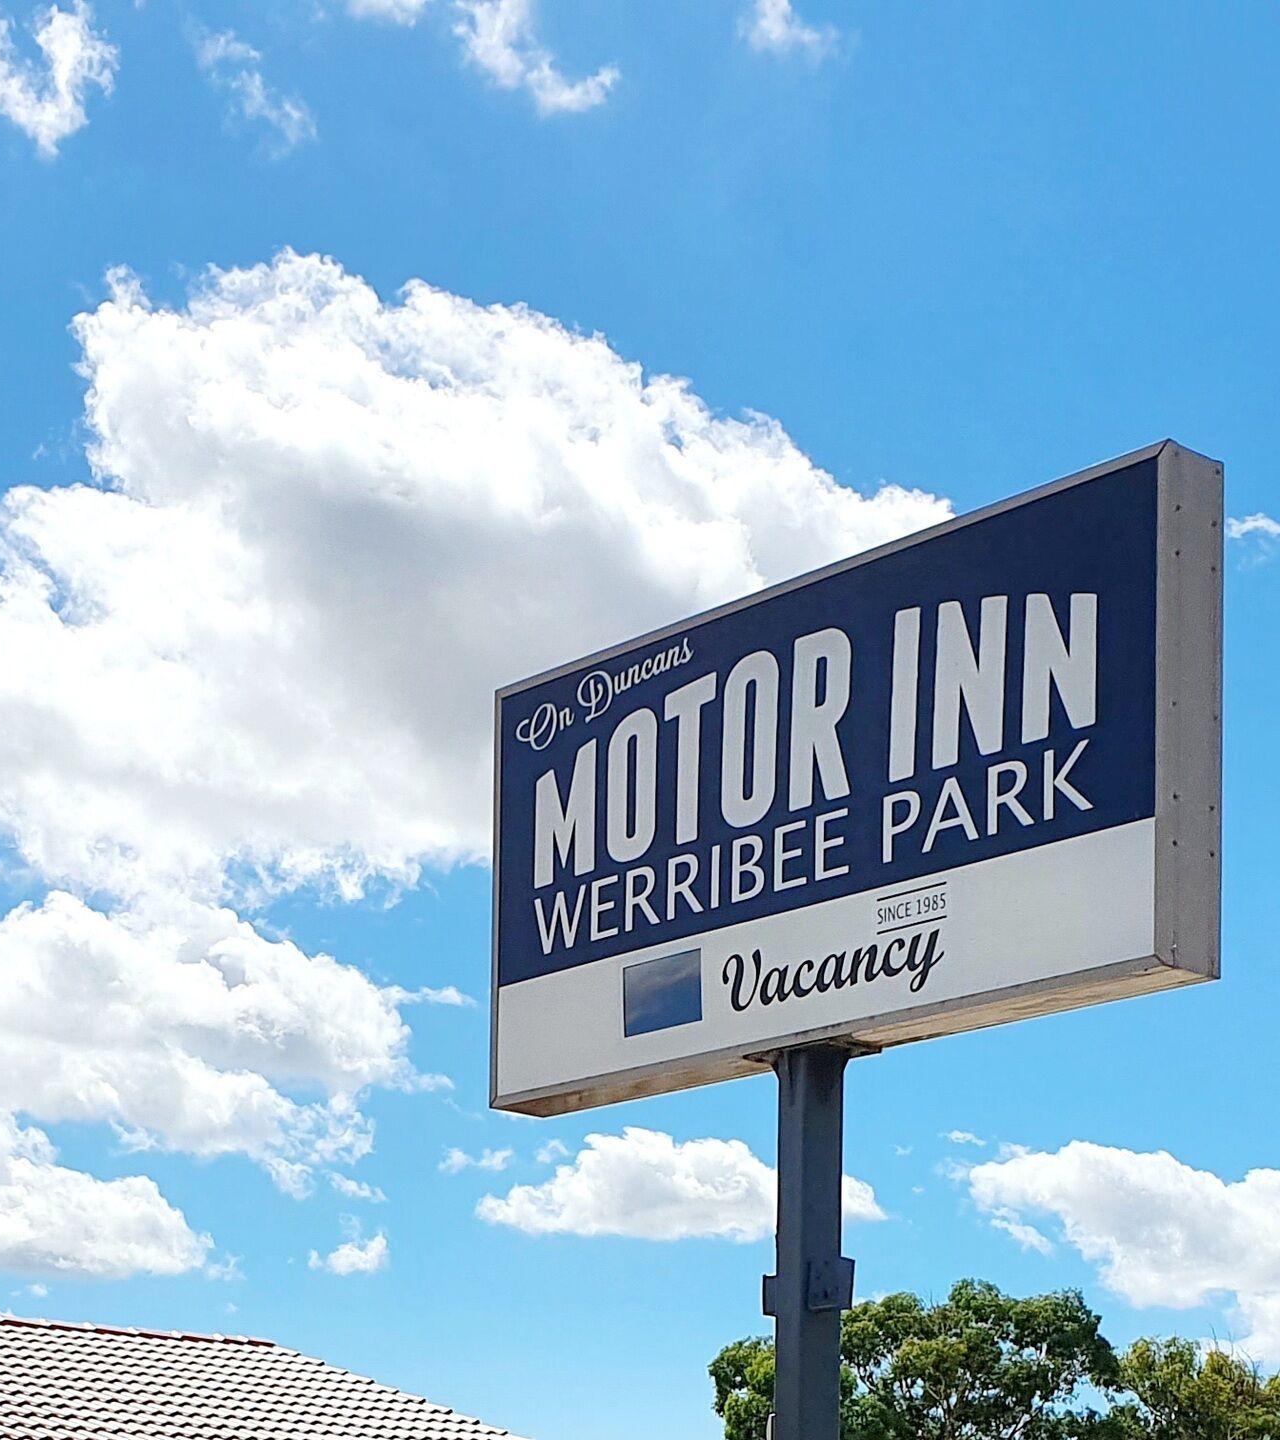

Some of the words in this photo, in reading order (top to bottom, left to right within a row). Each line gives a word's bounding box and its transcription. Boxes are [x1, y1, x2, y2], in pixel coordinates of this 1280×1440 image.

[516, 703, 575, 751] On
[577, 637, 694, 724] Duncans
[533, 627, 853, 889] MOTOR
[888, 593, 1098, 783] INN
[534, 807, 850, 955] WERRIBEE
[881, 738, 1094, 864] PARK
[877, 901, 913, 925] SINCE
[916, 892, 947, 915] 1985
[722, 928, 946, 1012] Vacancy
